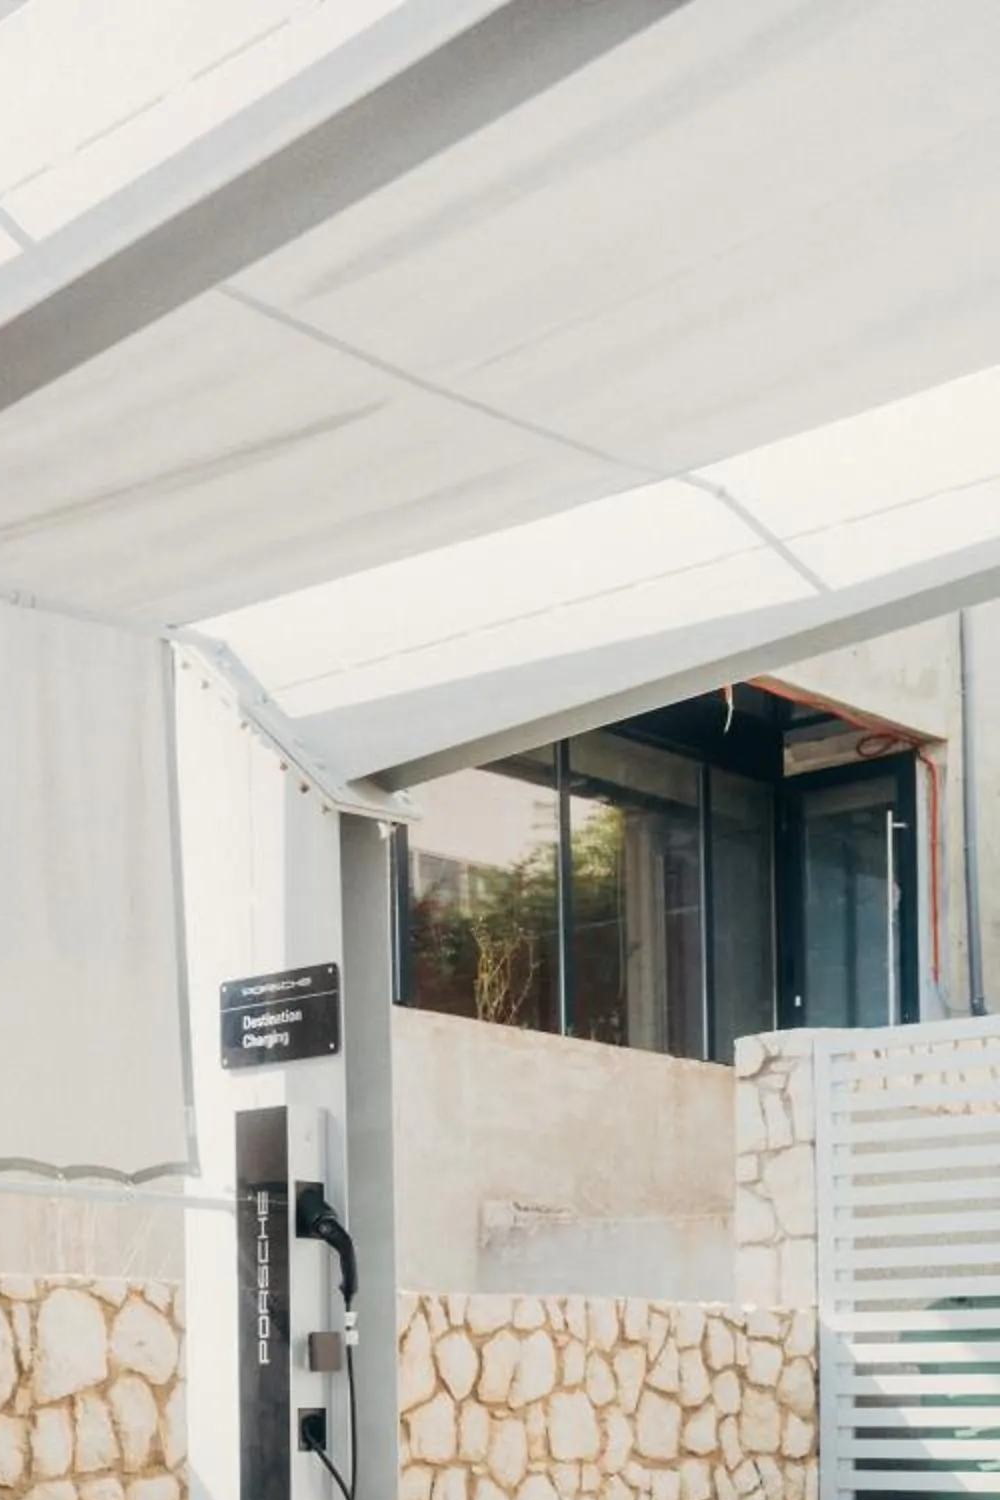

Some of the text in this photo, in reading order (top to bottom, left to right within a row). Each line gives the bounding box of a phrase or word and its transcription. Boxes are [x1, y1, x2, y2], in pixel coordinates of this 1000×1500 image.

[242, 1010, 303, 1030] Destination
[242, 1032, 290, 1049] Charging
[257, 1190, 270, 1365] PORSCHE
